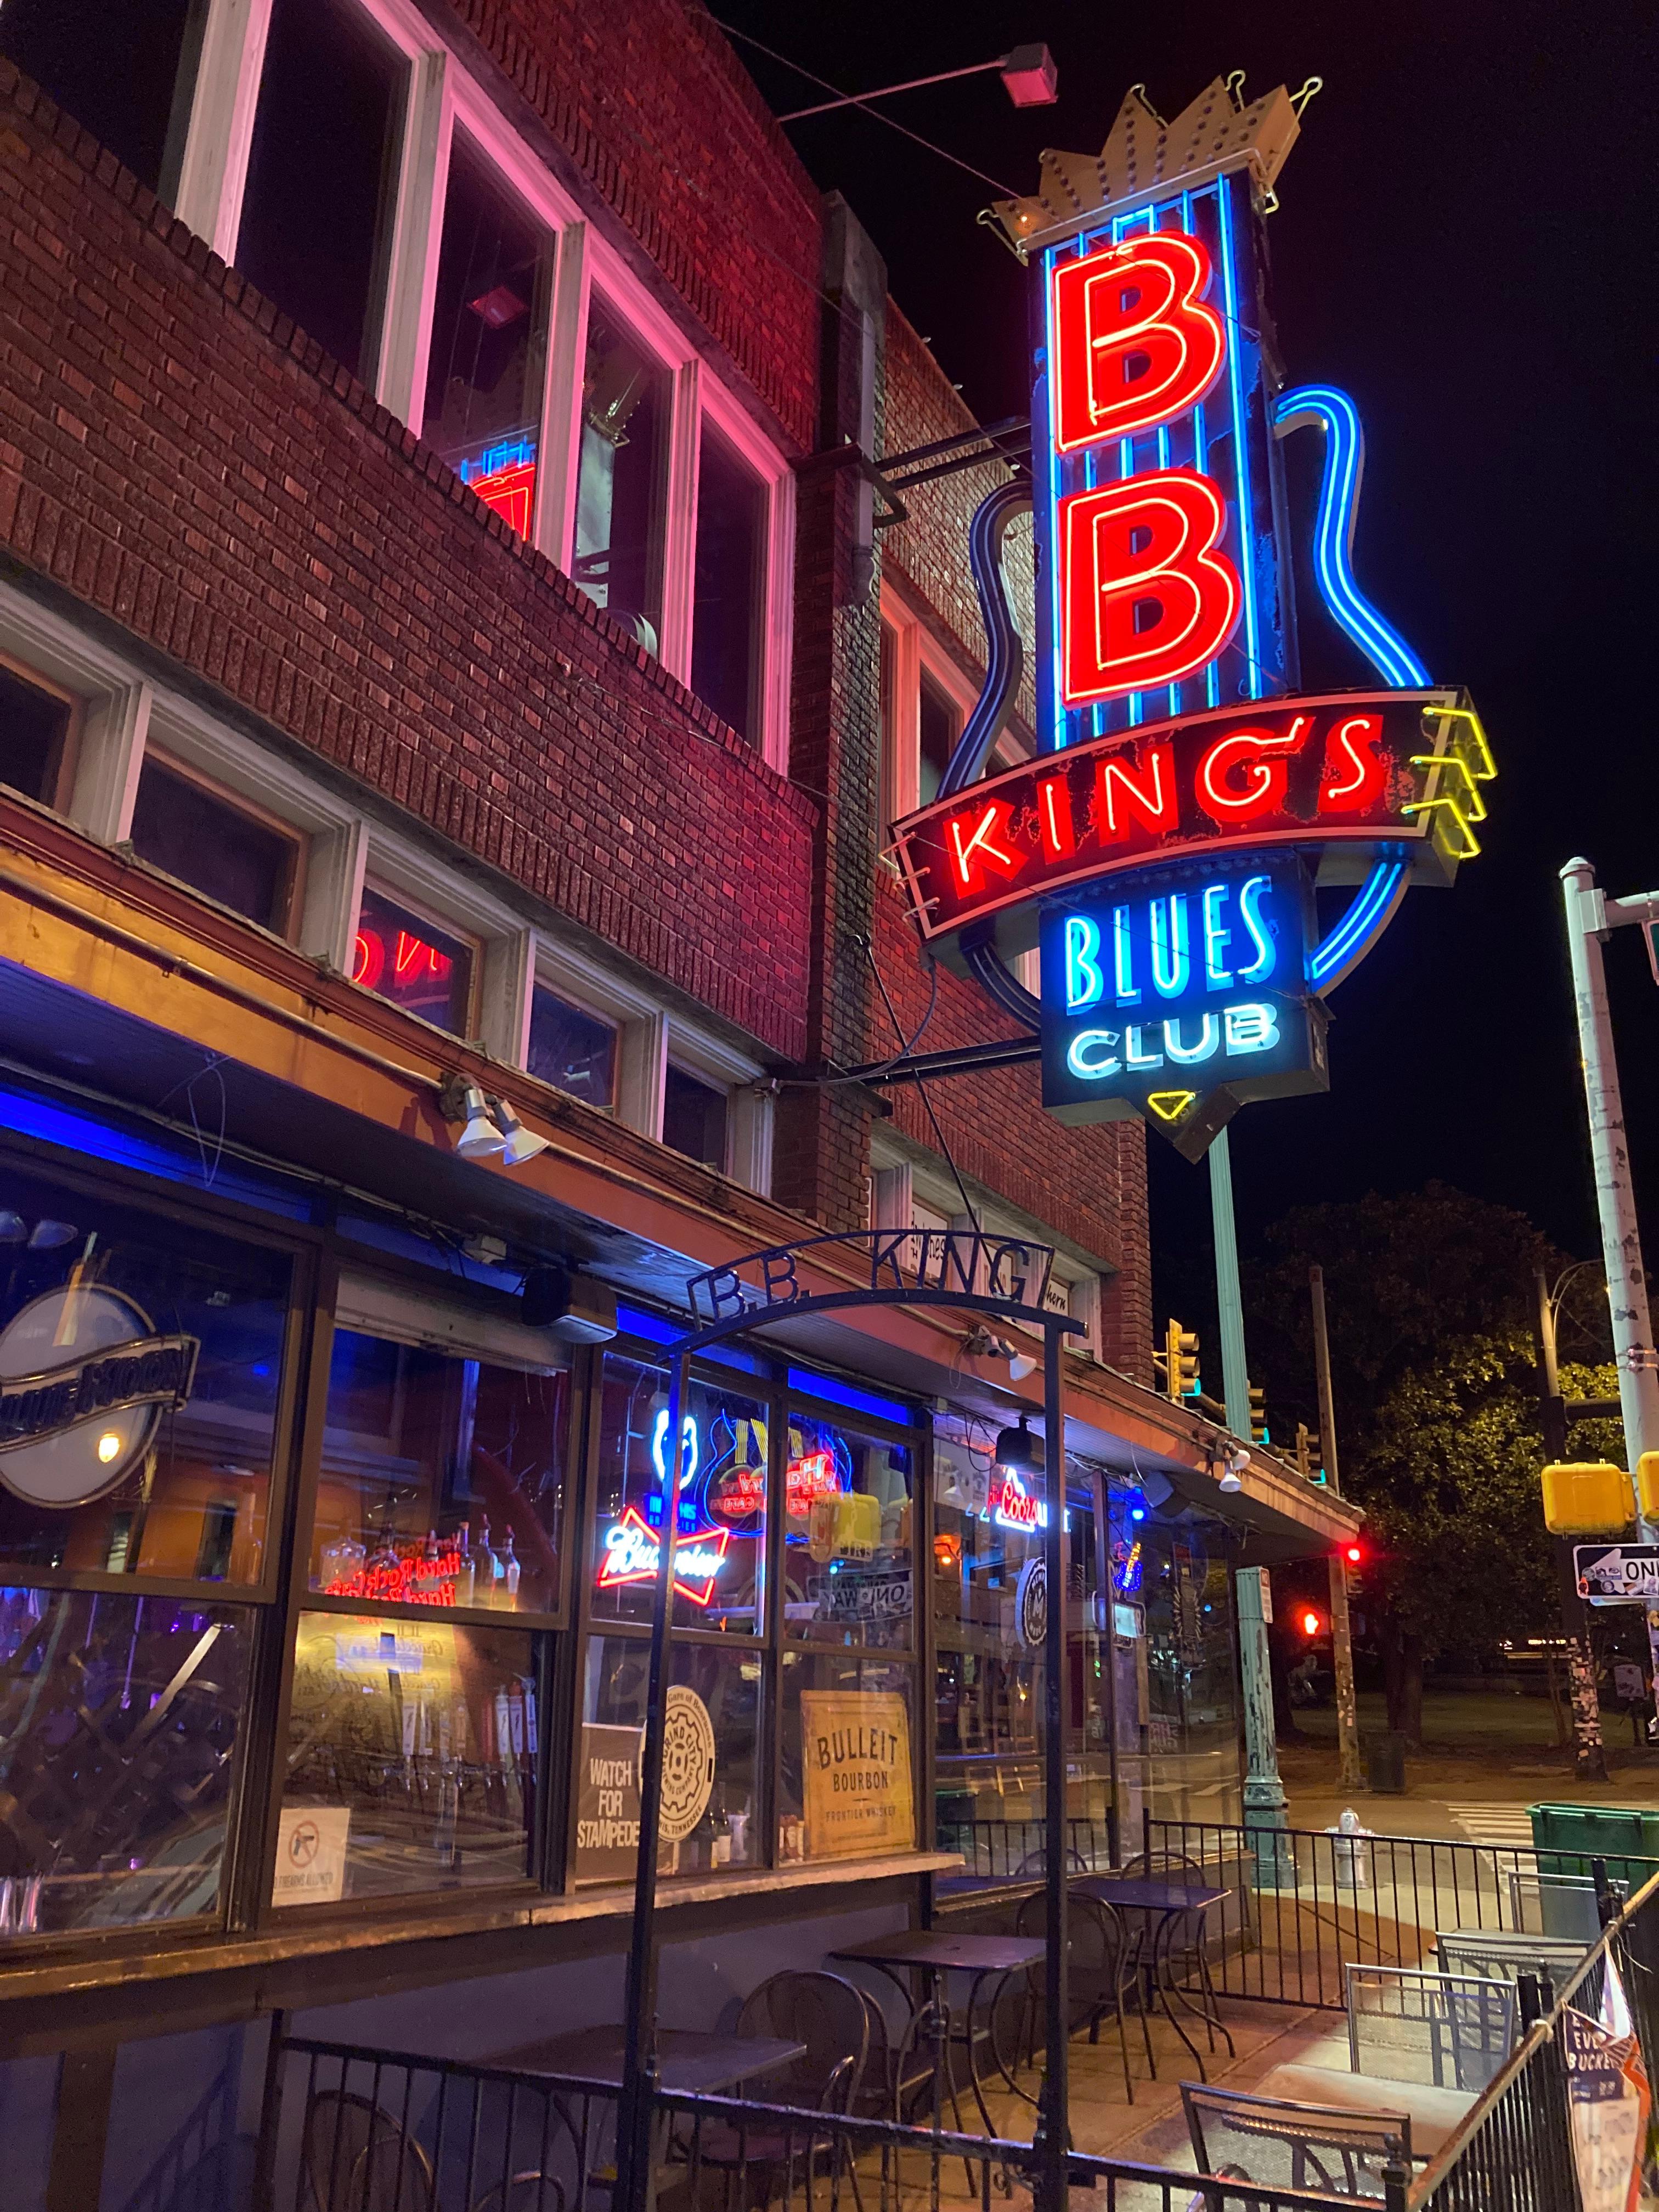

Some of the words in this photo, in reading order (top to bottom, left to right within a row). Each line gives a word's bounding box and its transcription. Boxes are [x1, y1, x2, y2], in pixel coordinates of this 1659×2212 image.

[1053, 229, 1227, 455] B
[1059, 467, 1243, 709] B
[943, 714, 1383, 899] KING'S
[1064, 874, 1278, 1014] BLUES
[1066, 1002, 1280, 1079] CLUB
[871, 1233, 1030, 1301] KING
[1002, 1481, 1038, 1526] Coors
[607, 1526, 725, 1577] Bueiser
[1626, 1561, 1659, 1581] ON
[686, 1734, 696, 1765] CITY
[817, 1727, 898, 1770] BULLEIT
[590, 1758, 631, 1787] WATCH
[833, 1771, 888, 1792] BOURBON
[598, 1790, 623, 1818] FOR
[826, 1808, 863, 1822] FRONTIER
[577, 1819, 641, 1849] STAMPEDE
